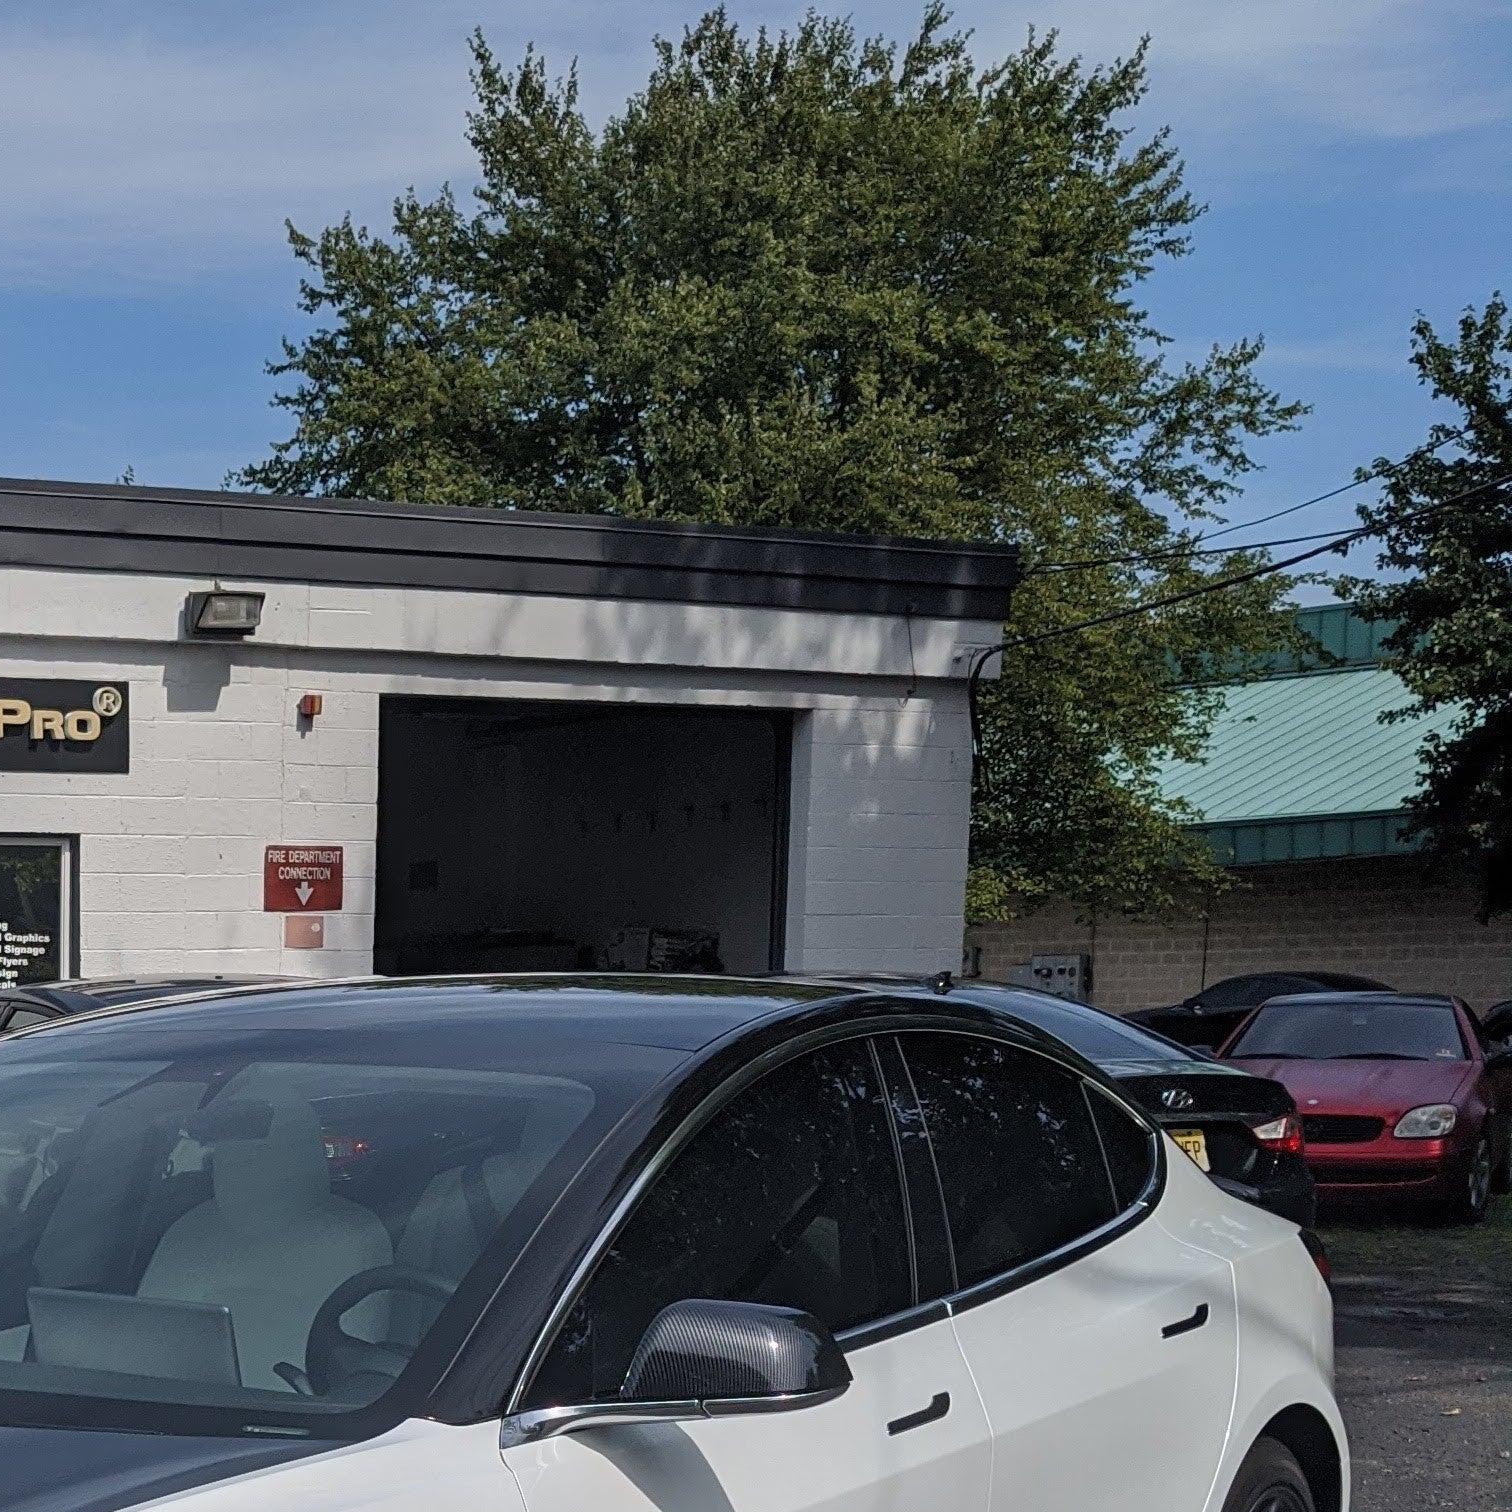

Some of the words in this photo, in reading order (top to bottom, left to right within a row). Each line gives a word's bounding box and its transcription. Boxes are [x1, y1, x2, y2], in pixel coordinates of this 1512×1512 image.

[268, 850, 286, 863] FIRE
[289, 850, 341, 864] DEPARTMENT
[278, 866, 331, 880] CONNECTION
[4, 933, 50, 944] Graphics
[4, 945, 45, 956] Signage
